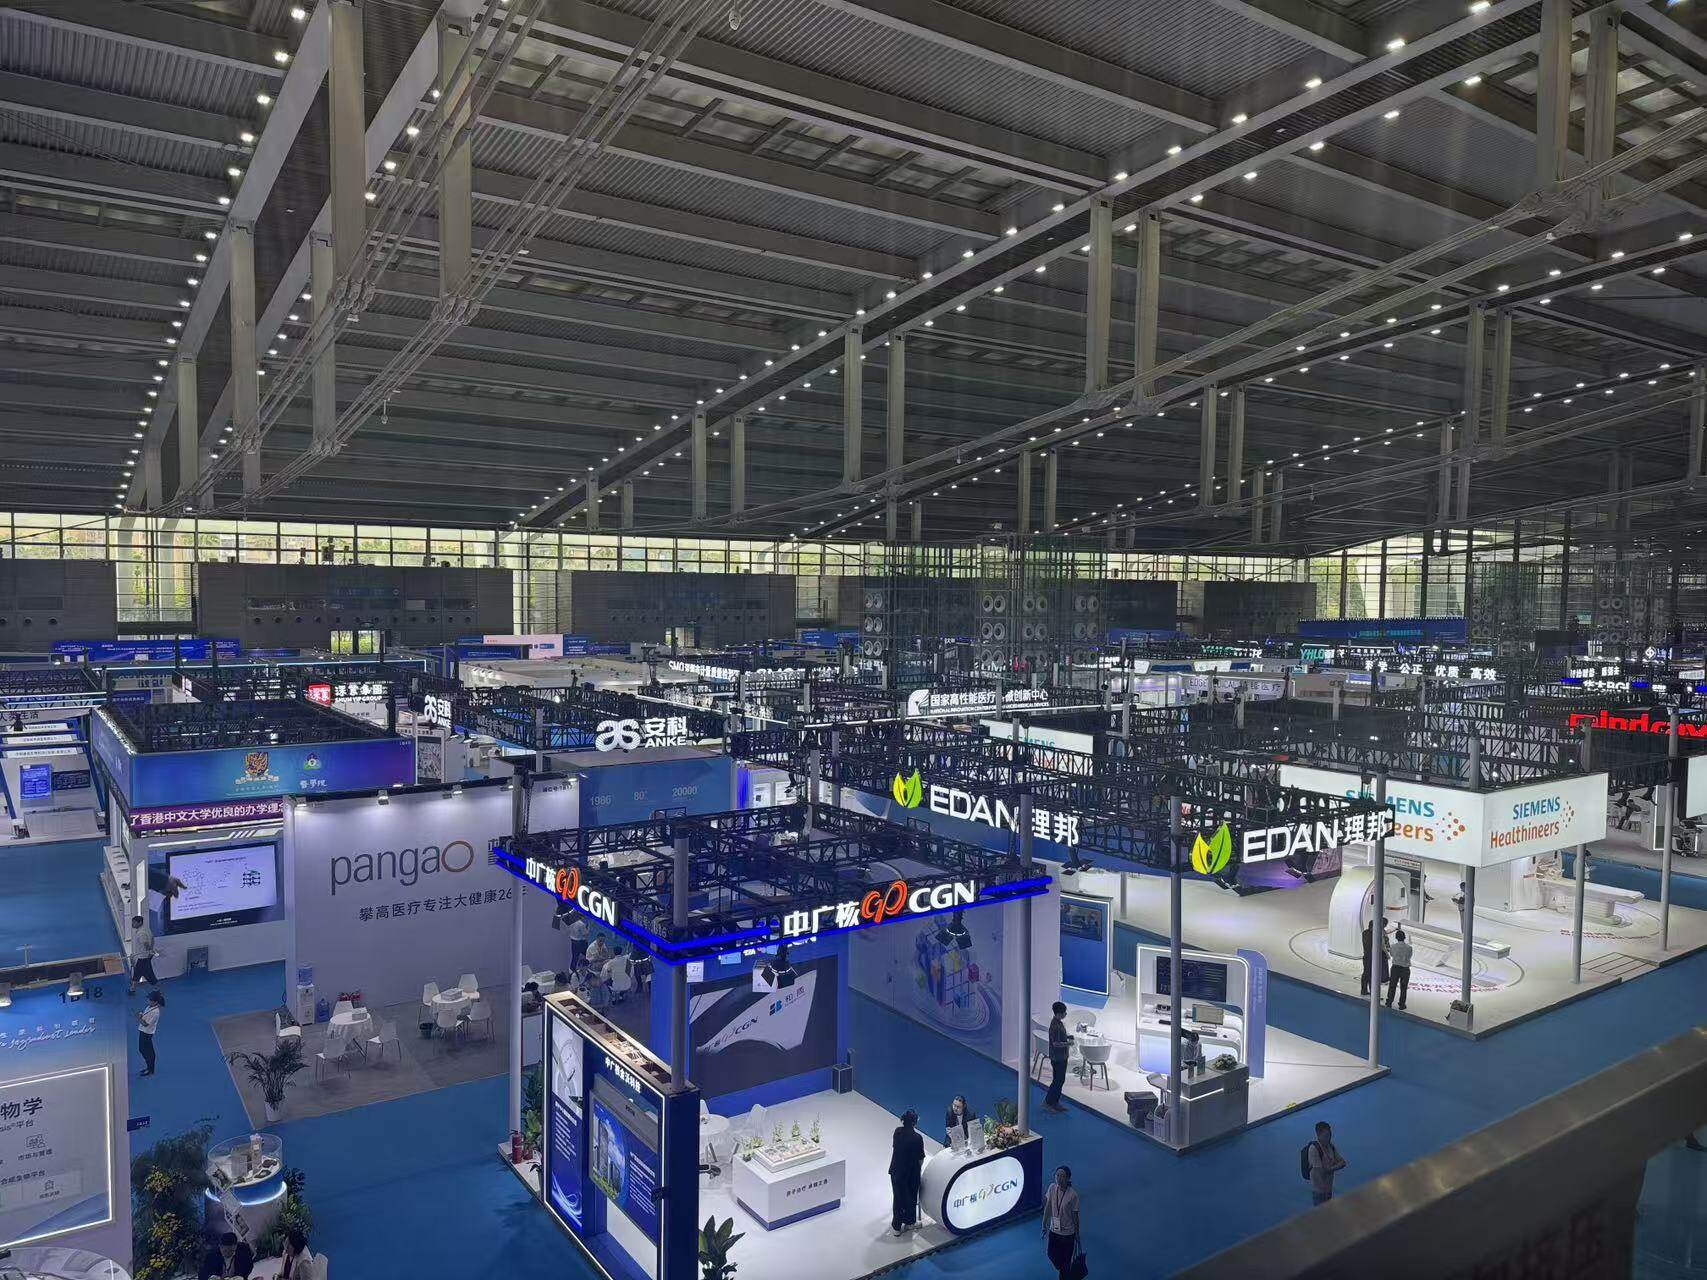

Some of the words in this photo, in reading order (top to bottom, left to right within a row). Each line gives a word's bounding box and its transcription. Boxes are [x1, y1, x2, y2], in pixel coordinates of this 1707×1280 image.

[1400, 663, 1424, 675] 公正
[1435, 665, 1460, 679] 优质
[1470, 667, 1497, 681] 高效
[930, 689, 1048, 707] 国家高性能医疗械创新中心
[644, 716, 687, 737] 安科
[644, 736, 687, 748] ANKE
[930, 785, 1019, 833] EDAN
[1512, 796, 1561, 820] SIEMENS
[1243, 819, 1339, 863] EDAN
[1344, 808, 1394, 844] 理邦
[1490, 821, 1560, 849] Healthineers
[331, 840, 474, 896] pangao
[359, 885, 527, 922] 攀高医疗专注大健康26
[525, 858, 556, 893] 中广核
[577, 885, 615, 927] CGN
[783, 900, 860, 938] 中广核
[909, 880, 975, 913] CGN
[0, 1096, 43, 1120] 物学
[953, 1192, 978, 1208] 中广核
[993, 1178, 1018, 1194] CGN
